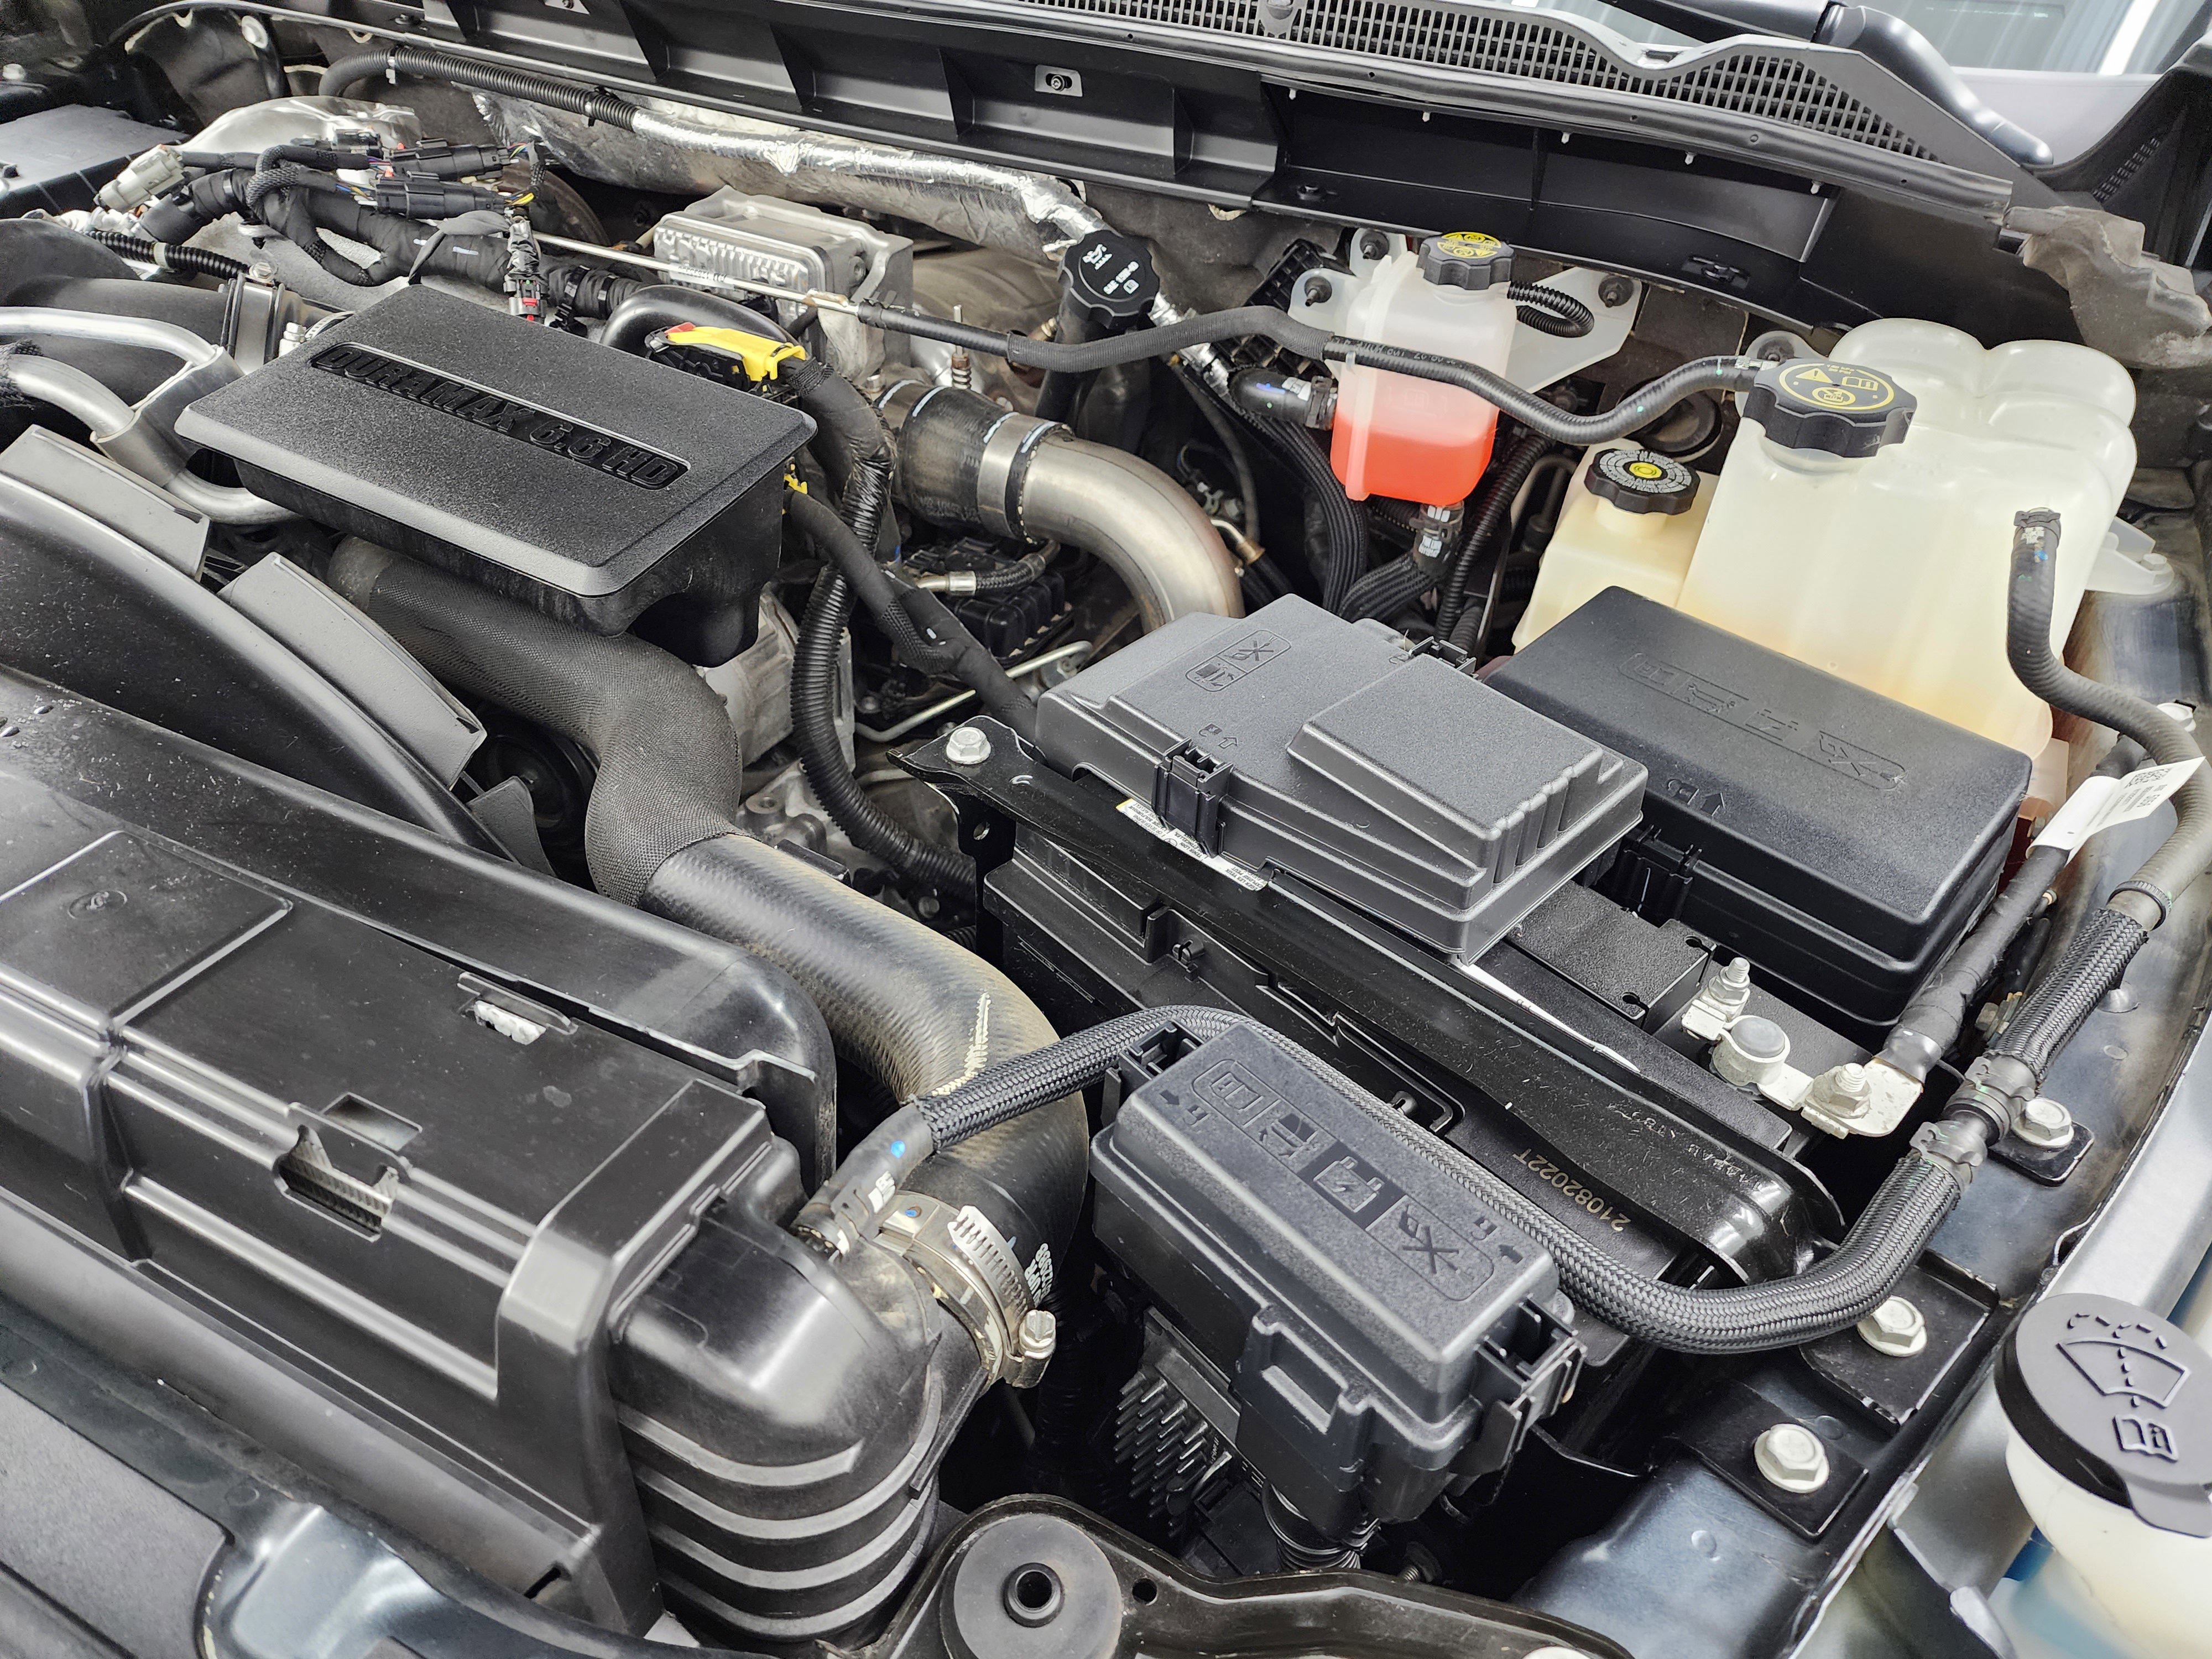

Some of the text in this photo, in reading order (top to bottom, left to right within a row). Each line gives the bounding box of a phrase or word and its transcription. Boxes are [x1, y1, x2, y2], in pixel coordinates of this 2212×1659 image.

[1103, 261, 1139, 294] SAE 15W-40
[315, 346, 679, 486] DURAMAX 6.6 HD
[1179, 842, 1190, 850] LOIN
[1224, 868, 1238, 878] YEUX
[1512, 1149, 1631, 1232] 21082022T
